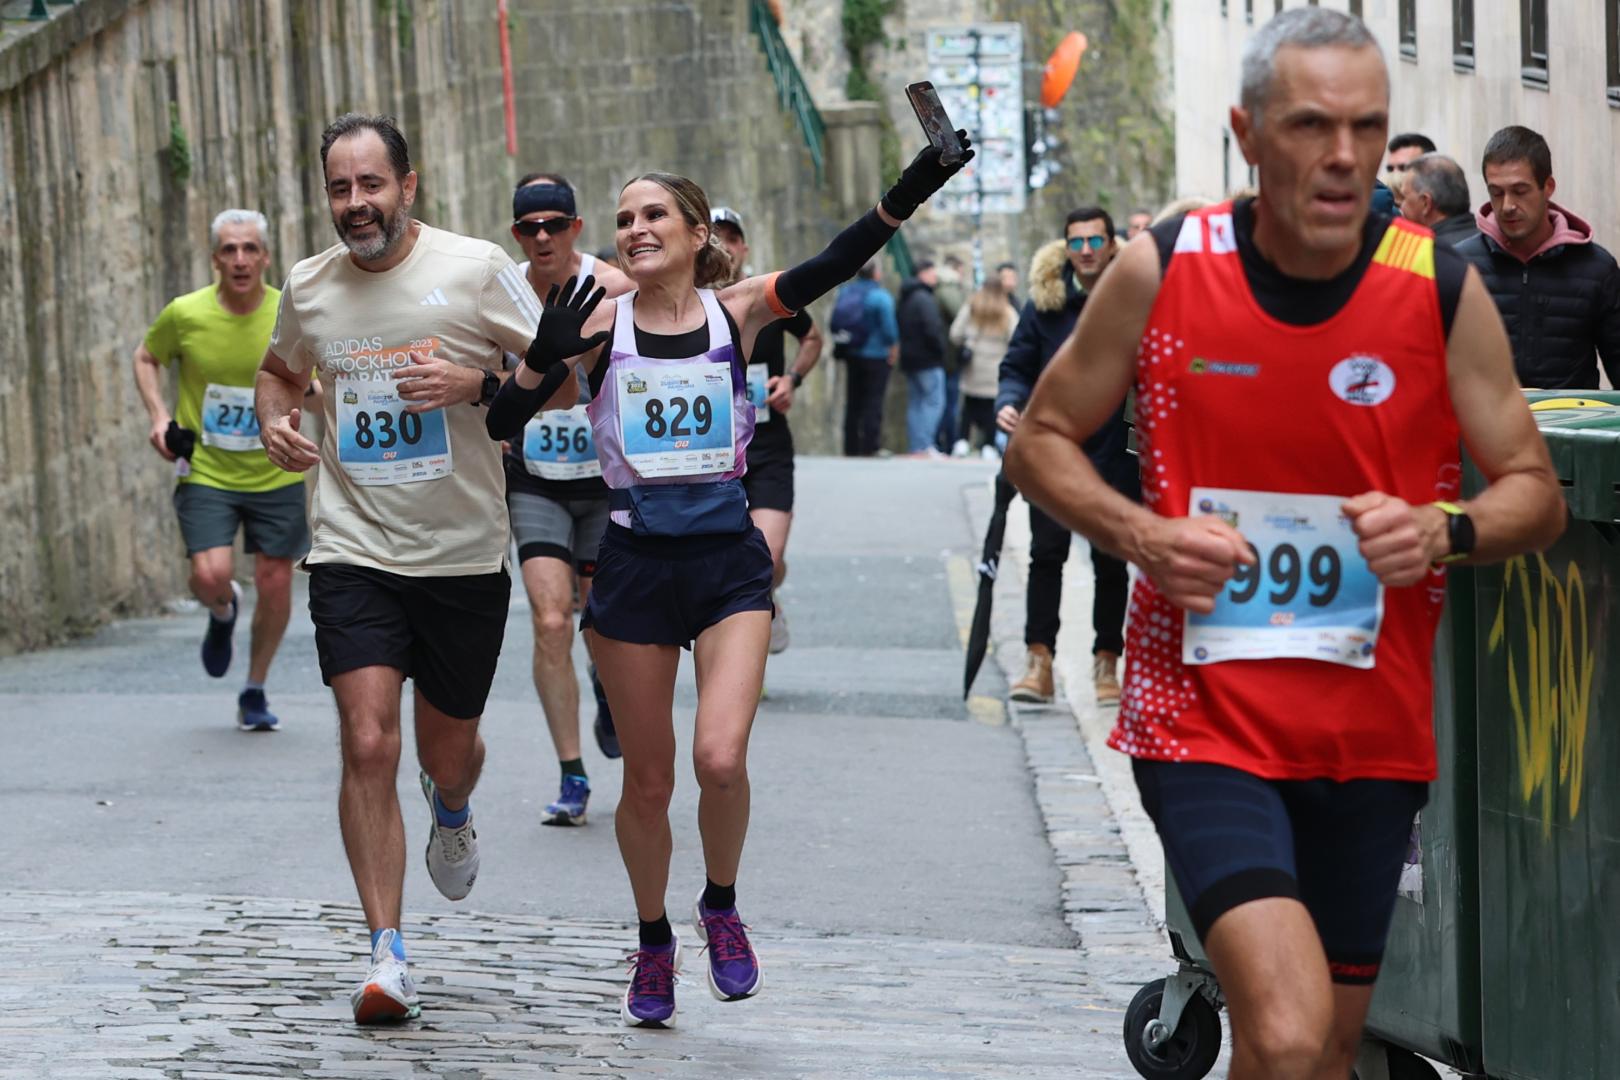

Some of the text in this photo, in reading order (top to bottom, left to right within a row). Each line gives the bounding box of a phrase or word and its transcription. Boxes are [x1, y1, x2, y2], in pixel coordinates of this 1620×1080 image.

[324, 336, 383, 357] ADIDAS
[409, 339, 433, 349] 2023
[355, 409, 422, 449] 830
[645, 395, 712, 438] 829
[540, 425, 588, 453] 356
[1229, 541, 1342, 608] 999
